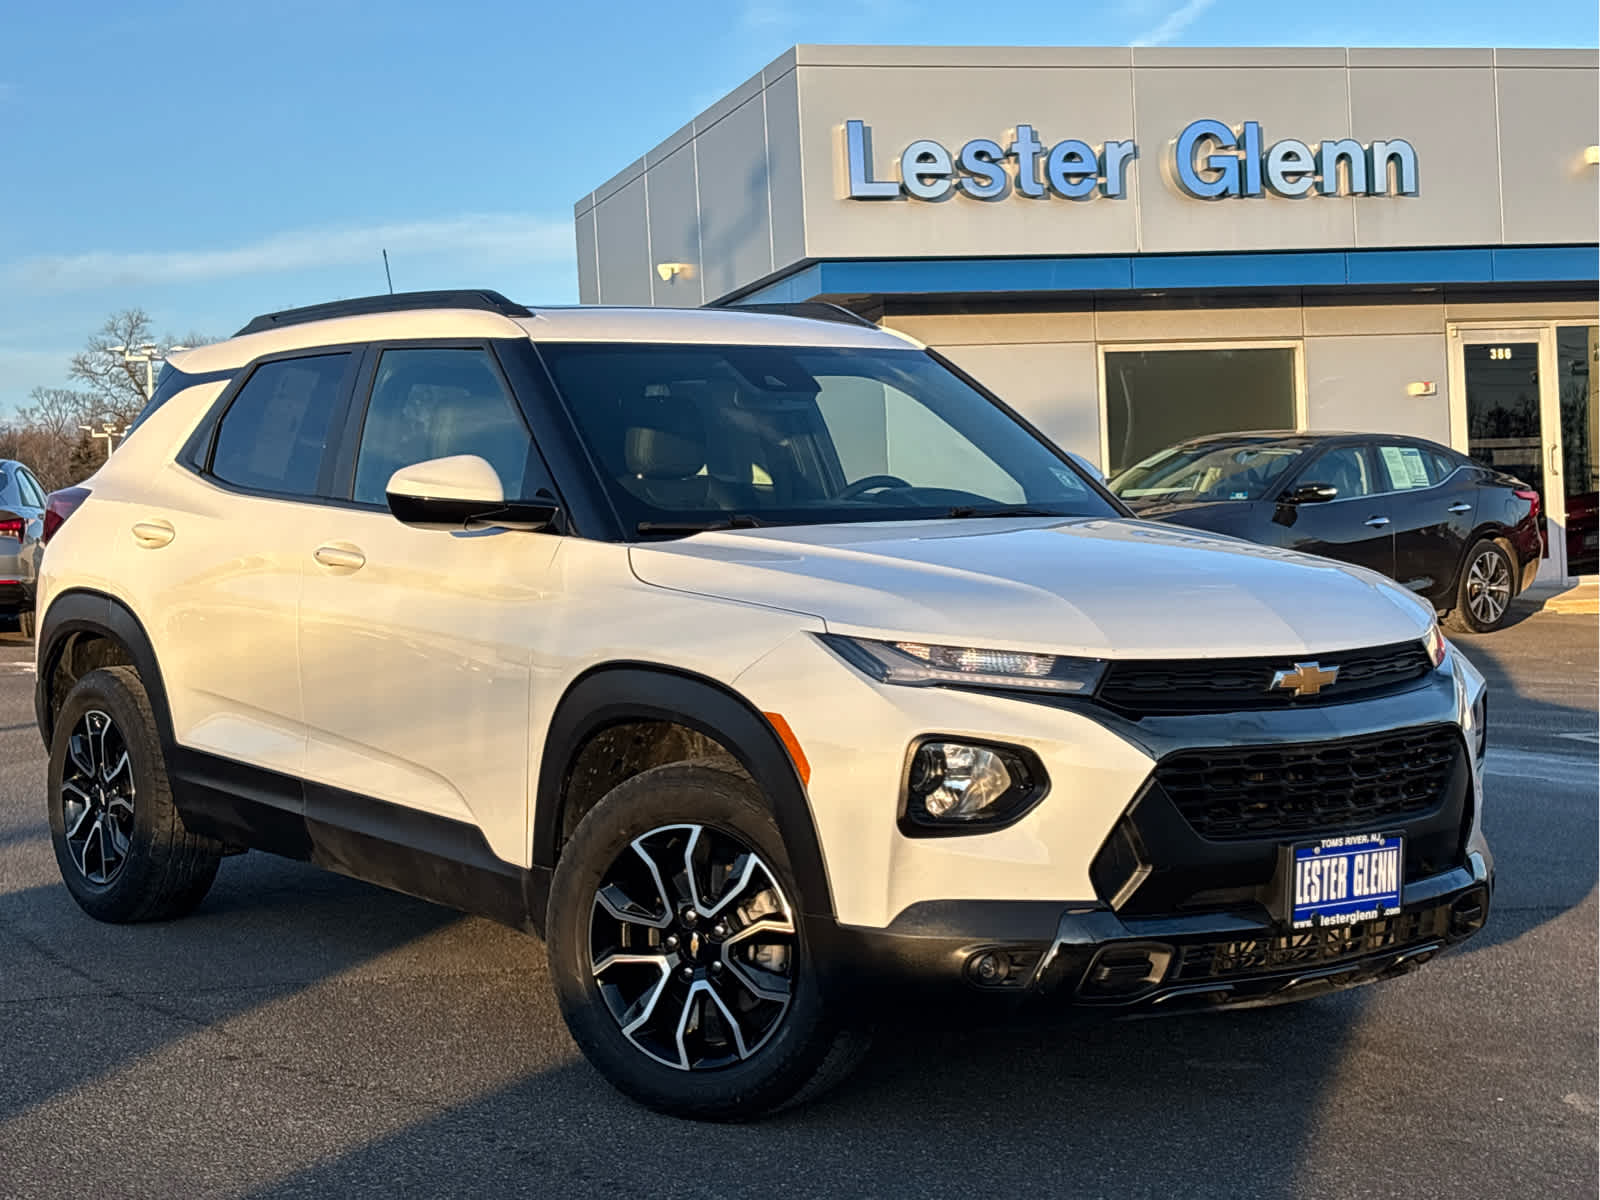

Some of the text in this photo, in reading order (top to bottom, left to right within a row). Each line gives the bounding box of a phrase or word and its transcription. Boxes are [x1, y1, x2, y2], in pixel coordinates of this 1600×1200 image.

[845, 118, 1418, 200] Lester Glenn
[1321, 838, 1343, 849] TOMS
[1295, 850, 1398, 905] LESTER GLENN
[1320, 910, 1378, 926] lesterglenn
